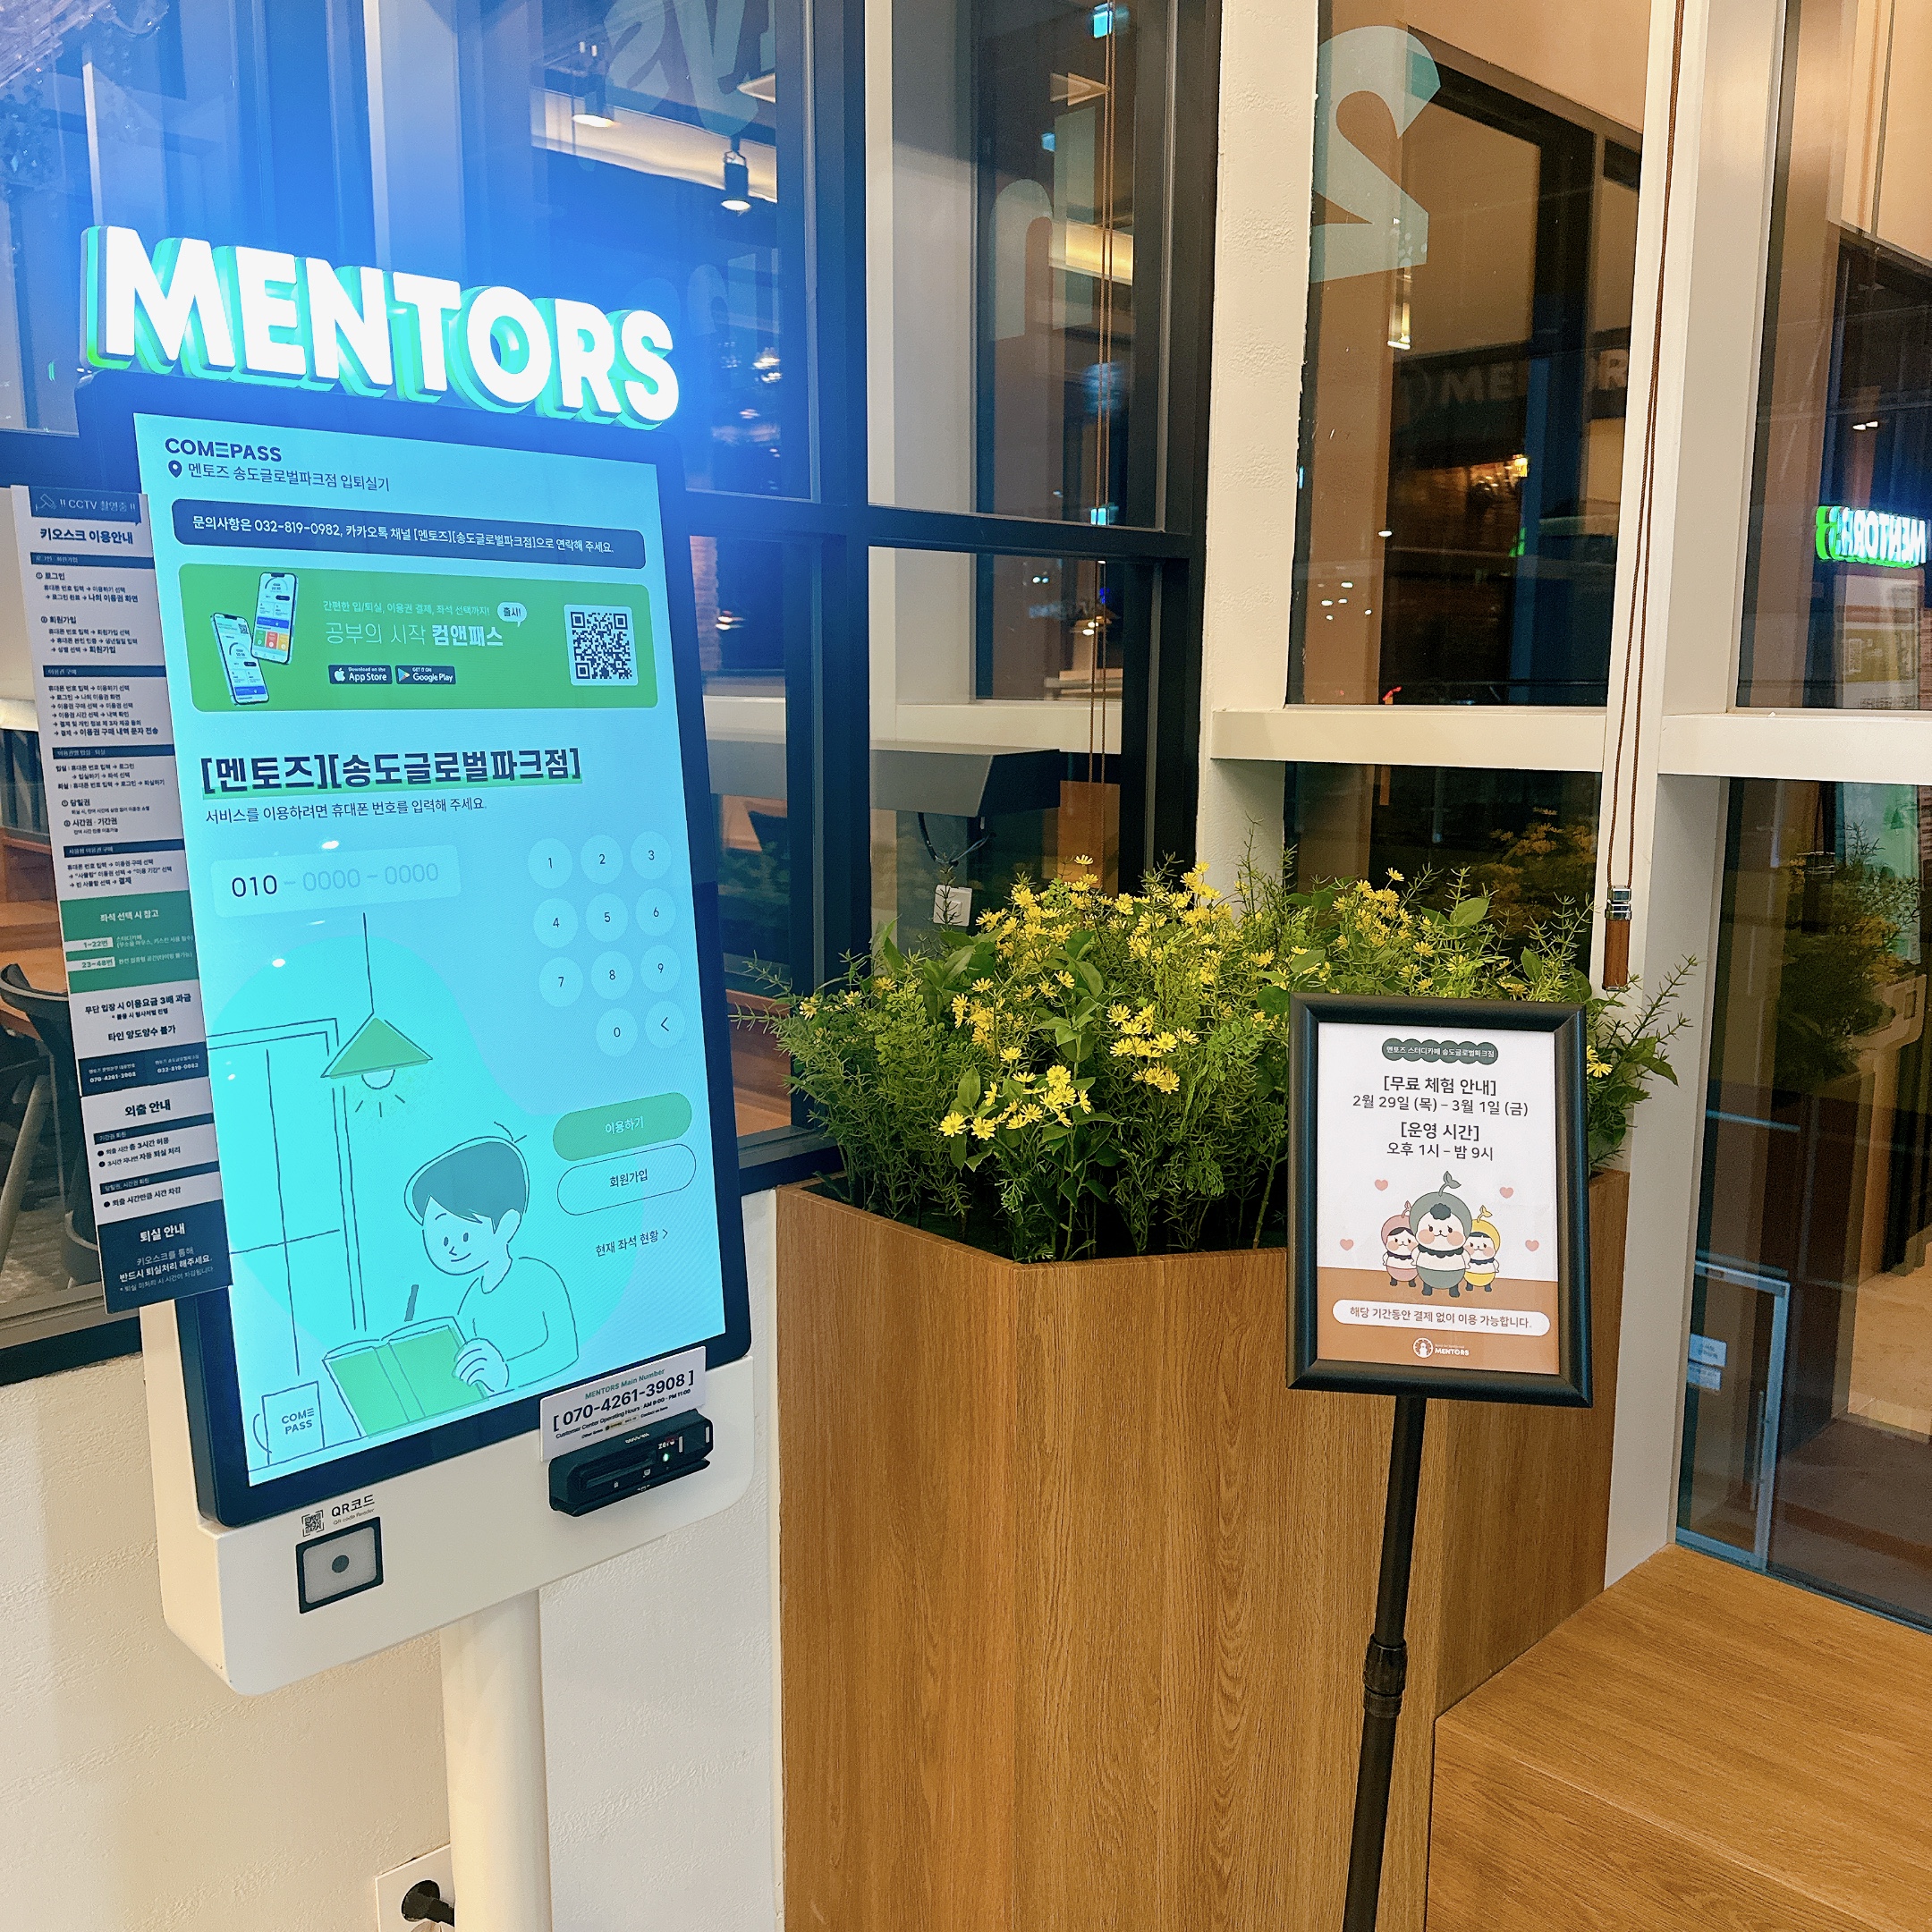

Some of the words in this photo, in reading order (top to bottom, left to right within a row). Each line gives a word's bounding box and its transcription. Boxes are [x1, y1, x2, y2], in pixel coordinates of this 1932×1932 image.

[83, 225, 681, 429] MENTORS
[188, 462, 230, 479] 멘토즈
[233, 466, 337, 488] 송도글로벌파크점
[340, 474, 390, 492] 입퇴실기
[68, 499, 97, 510] CCTV
[40, 528, 87, 541] 키오스크
[89, 530, 133, 545] 이용안내
[192, 515, 252, 532] 문의사항은
[254, 519, 343, 538] 032-819-0982,
[345, 524, 388, 540] 카카오톡
[390, 527, 411, 541] 채널
[413, 530, 555, 549] [멘토즈][송도글로벌파크점]으로
[556, 538, 583, 553] 연락해
[585, 540, 614, 554] 주세요.
[323, 600, 350, 613] 간편한
[352, 602, 385, 614] 입/퇴실,
[387, 603, 413, 614] 이용권
[414, 603, 435, 615] 결제,
[436, 605, 453, 615] 좌석
[454, 605, 490, 616] 선택까지!
[503, 606, 521, 617] 출시!
[325, 623, 383, 645] 공부의
[390, 623, 427, 645] 시작
[432, 624, 504, 647] 컴앤패스
[349, 672, 366, 682] App
[367, 672, 387, 682] Store
[413, 672, 438, 683] Google
[439, 673, 453, 683] Play
[200, 747, 580, 795] [멘토즈][송도글로벌파크점]
[206, 806, 259, 824] 서비스를
[263, 802, 328, 821] 이용하려면
[331, 801, 368, 818] 휴대폰
[371, 800, 408, 816] 번호를
[411, 798, 446, 814] 입력해
[449, 797, 487, 813] 주세요.
[72, 818, 93, 826] 시간권
[97, 817, 118, 826] 기간권
[547, 857, 554, 869] 1
[598, 853, 606, 865] 2
[648, 850, 656, 860] 3
[231, 873, 278, 898] 010
[302, 869, 360, 891] 0000
[384, 862, 438, 886] 0000
[134, 911, 142, 919] 시
[552, 917, 560, 928] 4
[604, 911, 611, 923] 5
[652, 907, 660, 918] 6
[557, 976, 564, 987] 7
[608, 969, 616, 980] 8
[657, 962, 665, 973] 9
[84, 1004, 100, 1014] 무단
[101, 1002, 116, 1012] 입장
[116, 1001, 125, 1010] 시
[125, 997, 158, 1010] 이용요금
[160, 995, 174, 1004] 3배
[175, 993, 192, 1003] 과금
[107, 1031, 125, 1042] 타인
[125, 1027, 159, 1040] 양도양수
[160, 1024, 176, 1034] 불가
[613, 1027, 621, 1038] 0
[1408, 1046, 1441, 1055] 스터디카페
[1383, 1075, 1420, 1092] [무료
[1425, 1077, 1455, 1094] 체험
[1460, 1079, 1496, 1096] 안내]
[124, 1103, 148, 1117] 외출
[148, 1098, 171, 1114] 안내
[1352, 1094, 1374, 1109] 2월
[1378, 1096, 1410, 1112] 29일
[1414, 1097, 1437, 1114] (목)
[1452, 1098, 1474, 1114] 3월
[1479, 1100, 1501, 1115] 1일
[1504, 1101, 1529, 1117] (금)
[605, 1115, 644, 1135] 이용하기
[1400, 1122, 1437, 1140] [운영
[1442, 1123, 1479, 1142] 시간]
[1386, 1141, 1414, 1157] 오후
[1419, 1143, 1440, 1158] 1시
[1453, 1145, 1467, 1159] 밤
[1471, 1147, 1494, 1161] 9시
[609, 1168, 648, 1188] 회원가입
[140, 1227, 162, 1242] 퇴실
[163, 1222, 186, 1238] 안내
[595, 1241, 615, 1258] 현재
[617, 1235, 638, 1250] 좌석
[640, 1229, 659, 1246] 현황
[136, 1249, 177, 1267] 키오스크를
[178, 1246, 194, 1258] 통해
[119, 1268, 144, 1284] 반드시
[146, 1260, 178, 1276] 퇴실처리
[179, 1254, 213, 1268] 해주세요.
[1349, 1306, 1370, 1319] 해당
[1372, 1308, 1411, 1322] 기간동안
[1413, 1310, 1433, 1323] 결제
[1436, 1312, 1455, 1325] 없이
[1457, 1313, 1478, 1326] 이용
[1479, 1315, 1533, 1329] 가능합니다.
[1434, 1347, 1470, 1357] MENTORS
[584, 1383, 620, 1400] MENTORS
[621, 1377, 638, 1388] Main
[639, 1368, 665, 1382] Number
[563, 1373, 685, 1426] 070-4261-3908
[281, 1407, 315, 1425] COME
[555, 1427, 581, 1439] Customer
[600, 1411, 624, 1424] Operating
[624, 1405, 640, 1415] Hours
[643, 1401, 653, 1409] AM
[284, 1419, 313, 1435] PASS
[331, 1494, 376, 1518] QR코드
